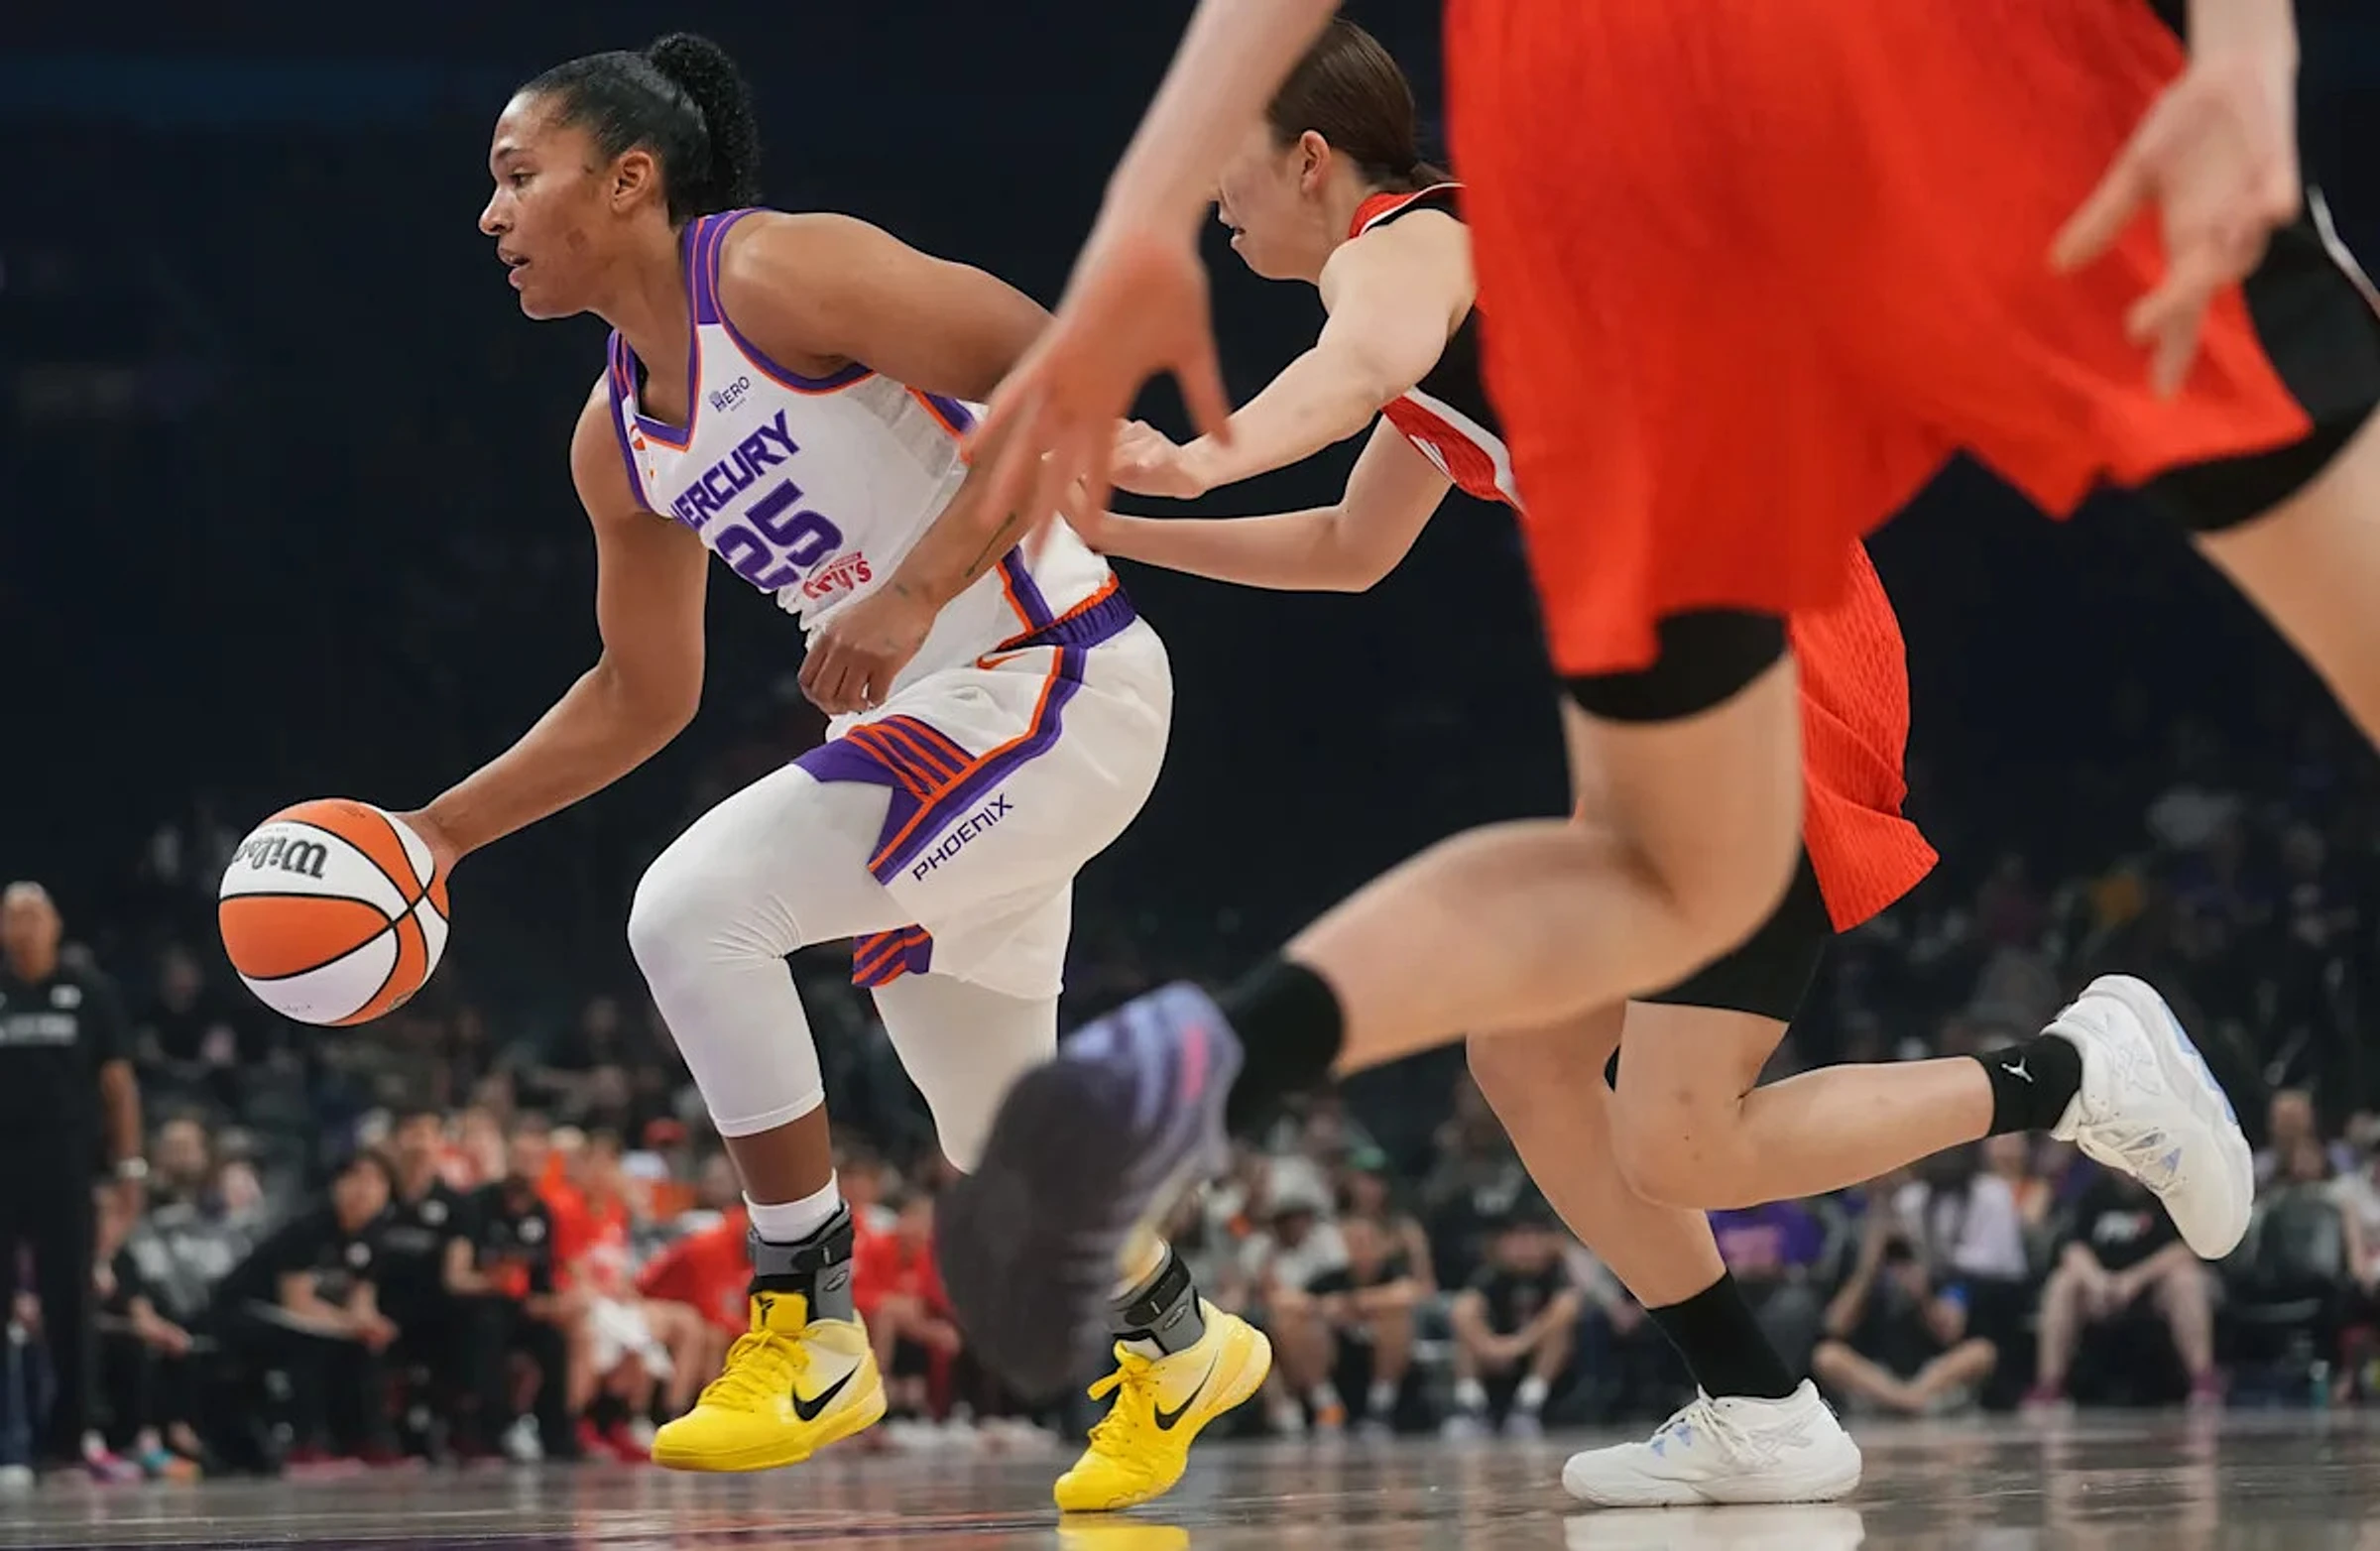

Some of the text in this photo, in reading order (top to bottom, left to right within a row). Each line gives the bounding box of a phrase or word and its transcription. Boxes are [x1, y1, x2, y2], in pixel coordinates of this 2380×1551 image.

[710, 376, 750, 413] HERO
[670, 408, 800, 530] ERCURY
[715, 478, 843, 590] 25
[232, 837, 328, 880] Wilso
[911, 792, 1013, 882] PHOENIX
